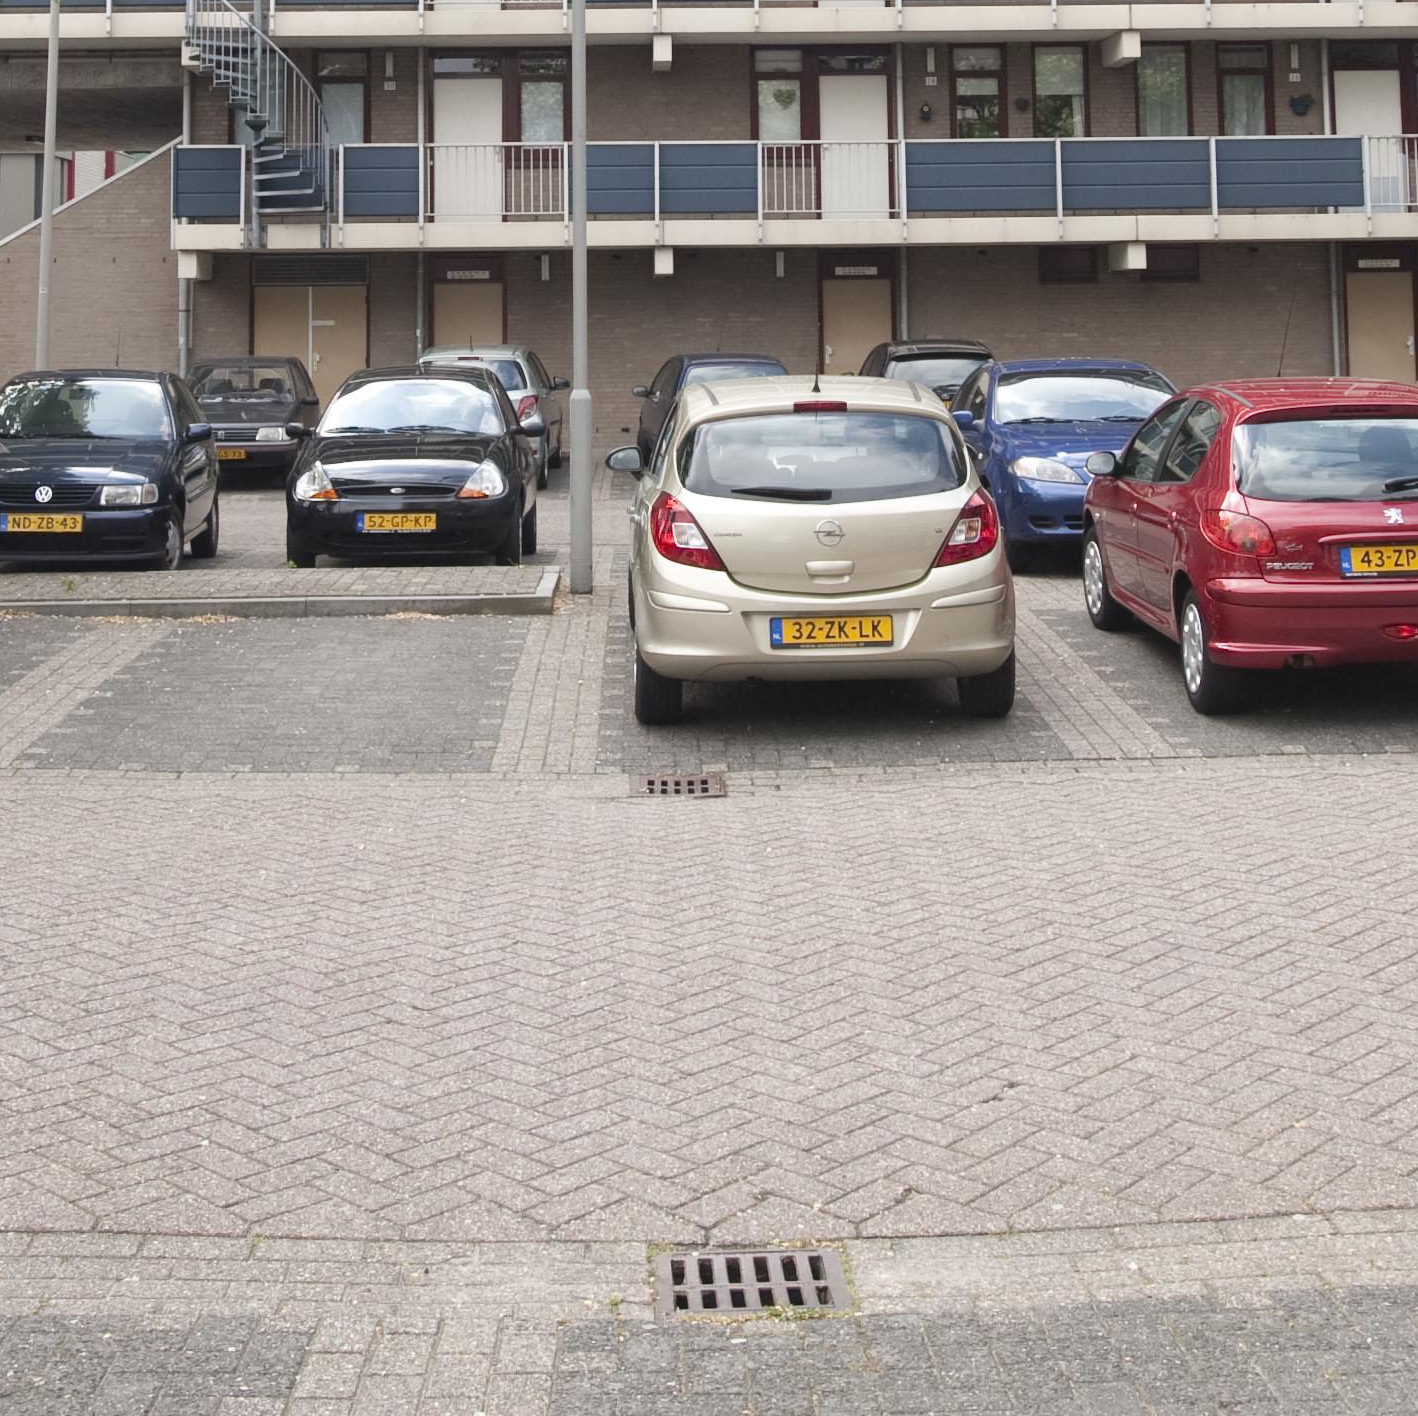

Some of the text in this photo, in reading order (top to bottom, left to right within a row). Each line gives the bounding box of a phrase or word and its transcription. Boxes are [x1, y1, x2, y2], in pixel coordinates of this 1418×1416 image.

[11, 516, 78, 530] ND-ZB-43
[368, 515, 432, 528] 52-GP-KP
[1266, 562, 1314, 570] PEUGEOT
[791, 619, 883, 640] 32-ZK-LK
